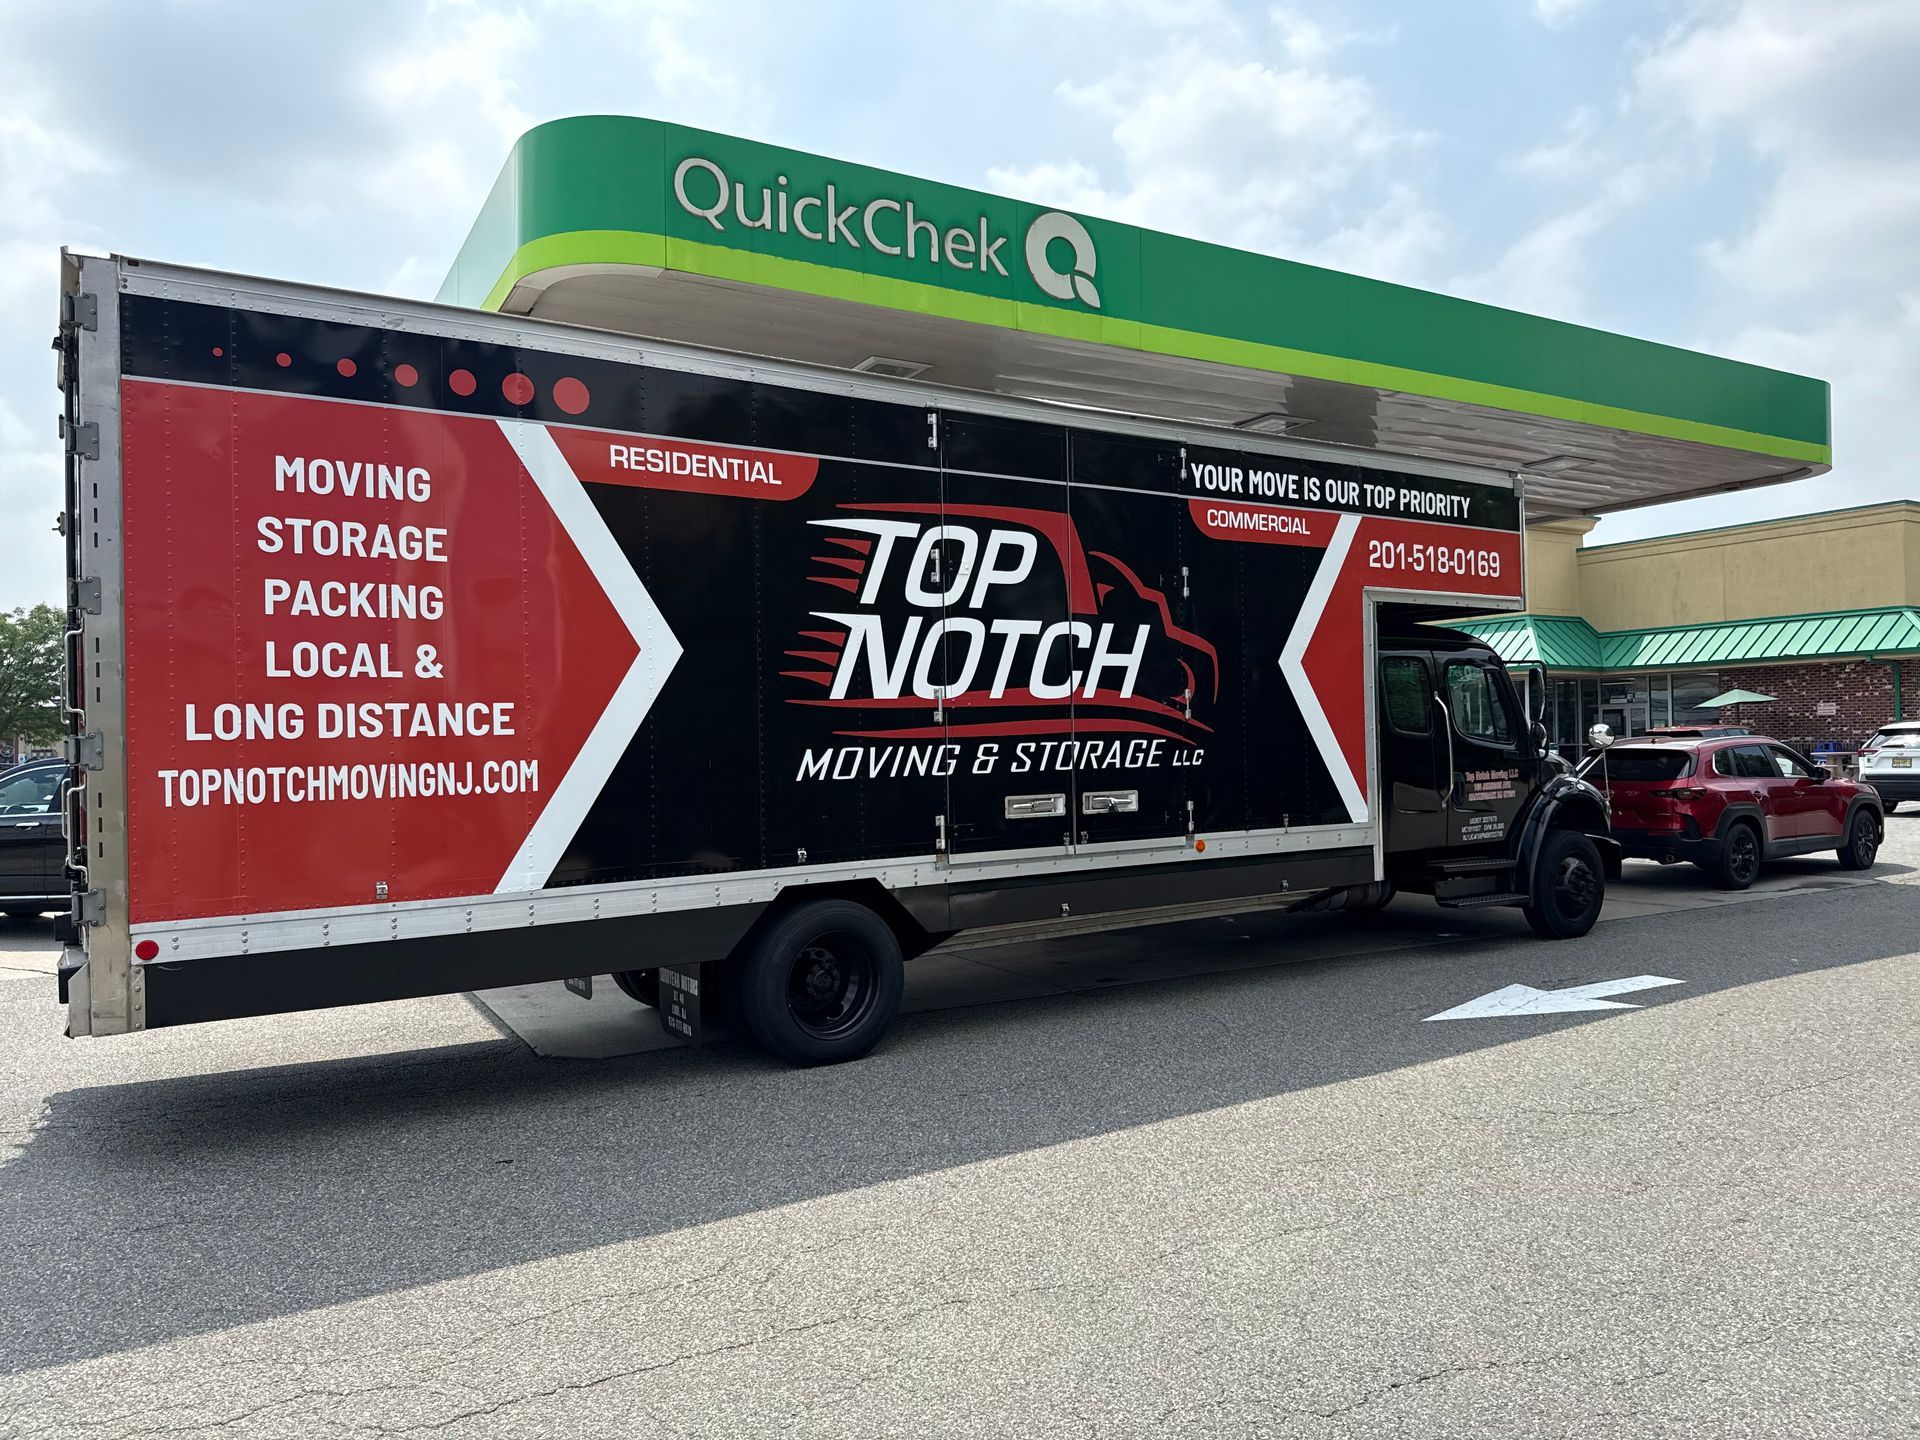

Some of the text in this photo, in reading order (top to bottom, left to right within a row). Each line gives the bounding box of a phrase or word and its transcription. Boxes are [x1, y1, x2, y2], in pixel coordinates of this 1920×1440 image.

[673, 156, 1010, 277] QuickChek
[275, 455, 431, 503] MOVING
[609, 444, 782, 485] RESIDENTIAL
[1190, 462, 1471, 519] YOUR MOVE IS OUR TOP PRIORITY
[257, 516, 448, 563] STORAGE
[1207, 509, 1311, 535] COMMERCIAL
[807, 519, 1037, 608] TOP
[1369, 540, 1500, 578] 201-518-0169
[264, 578, 444, 620] PACKING
[266, 641, 444, 679] LOCAL &
[809, 612, 1150, 699] NOTCH
[185, 702, 515, 741] LONG DISTANCE
[796, 740, 1205, 782] MOVING & STORAGE LLC
[1508, 768, 1519, 778] LLC
[157, 759, 539, 808] TOPNOTCHMOVINGNJ.COM
